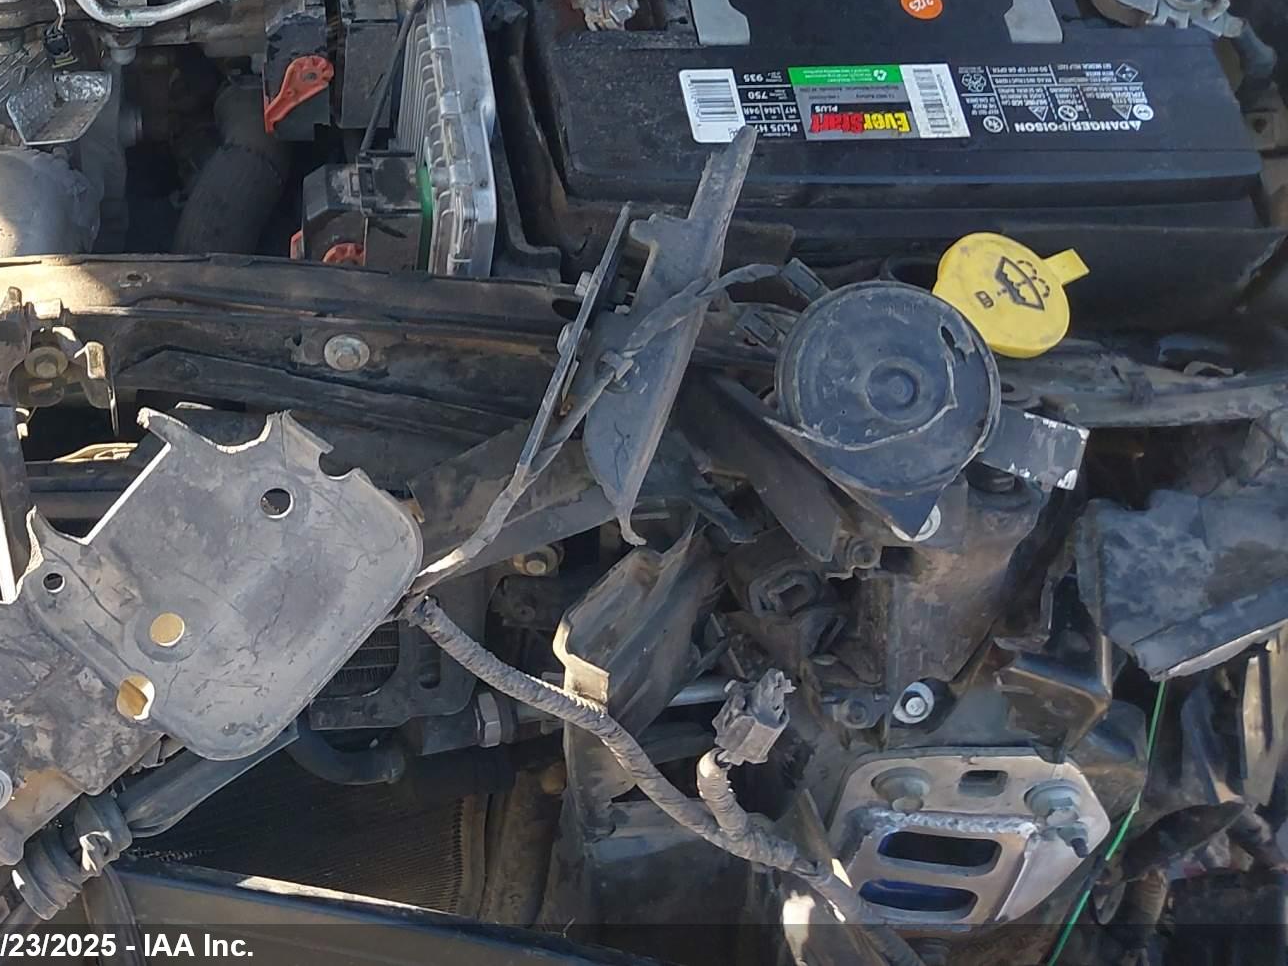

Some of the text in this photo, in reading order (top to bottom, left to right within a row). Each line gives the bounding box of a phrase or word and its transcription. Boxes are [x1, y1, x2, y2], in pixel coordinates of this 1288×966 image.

[744, 74, 763, 82] 935
[748, 91, 768, 99] 750
[785, 106, 796, 114] H7
[815, 105, 838, 113] PLUS
[810, 112, 911, 135] EverStart
[1014, 121, 1129, 132] DANGER/POISON
[770, 124, 797, 132] PLUS
